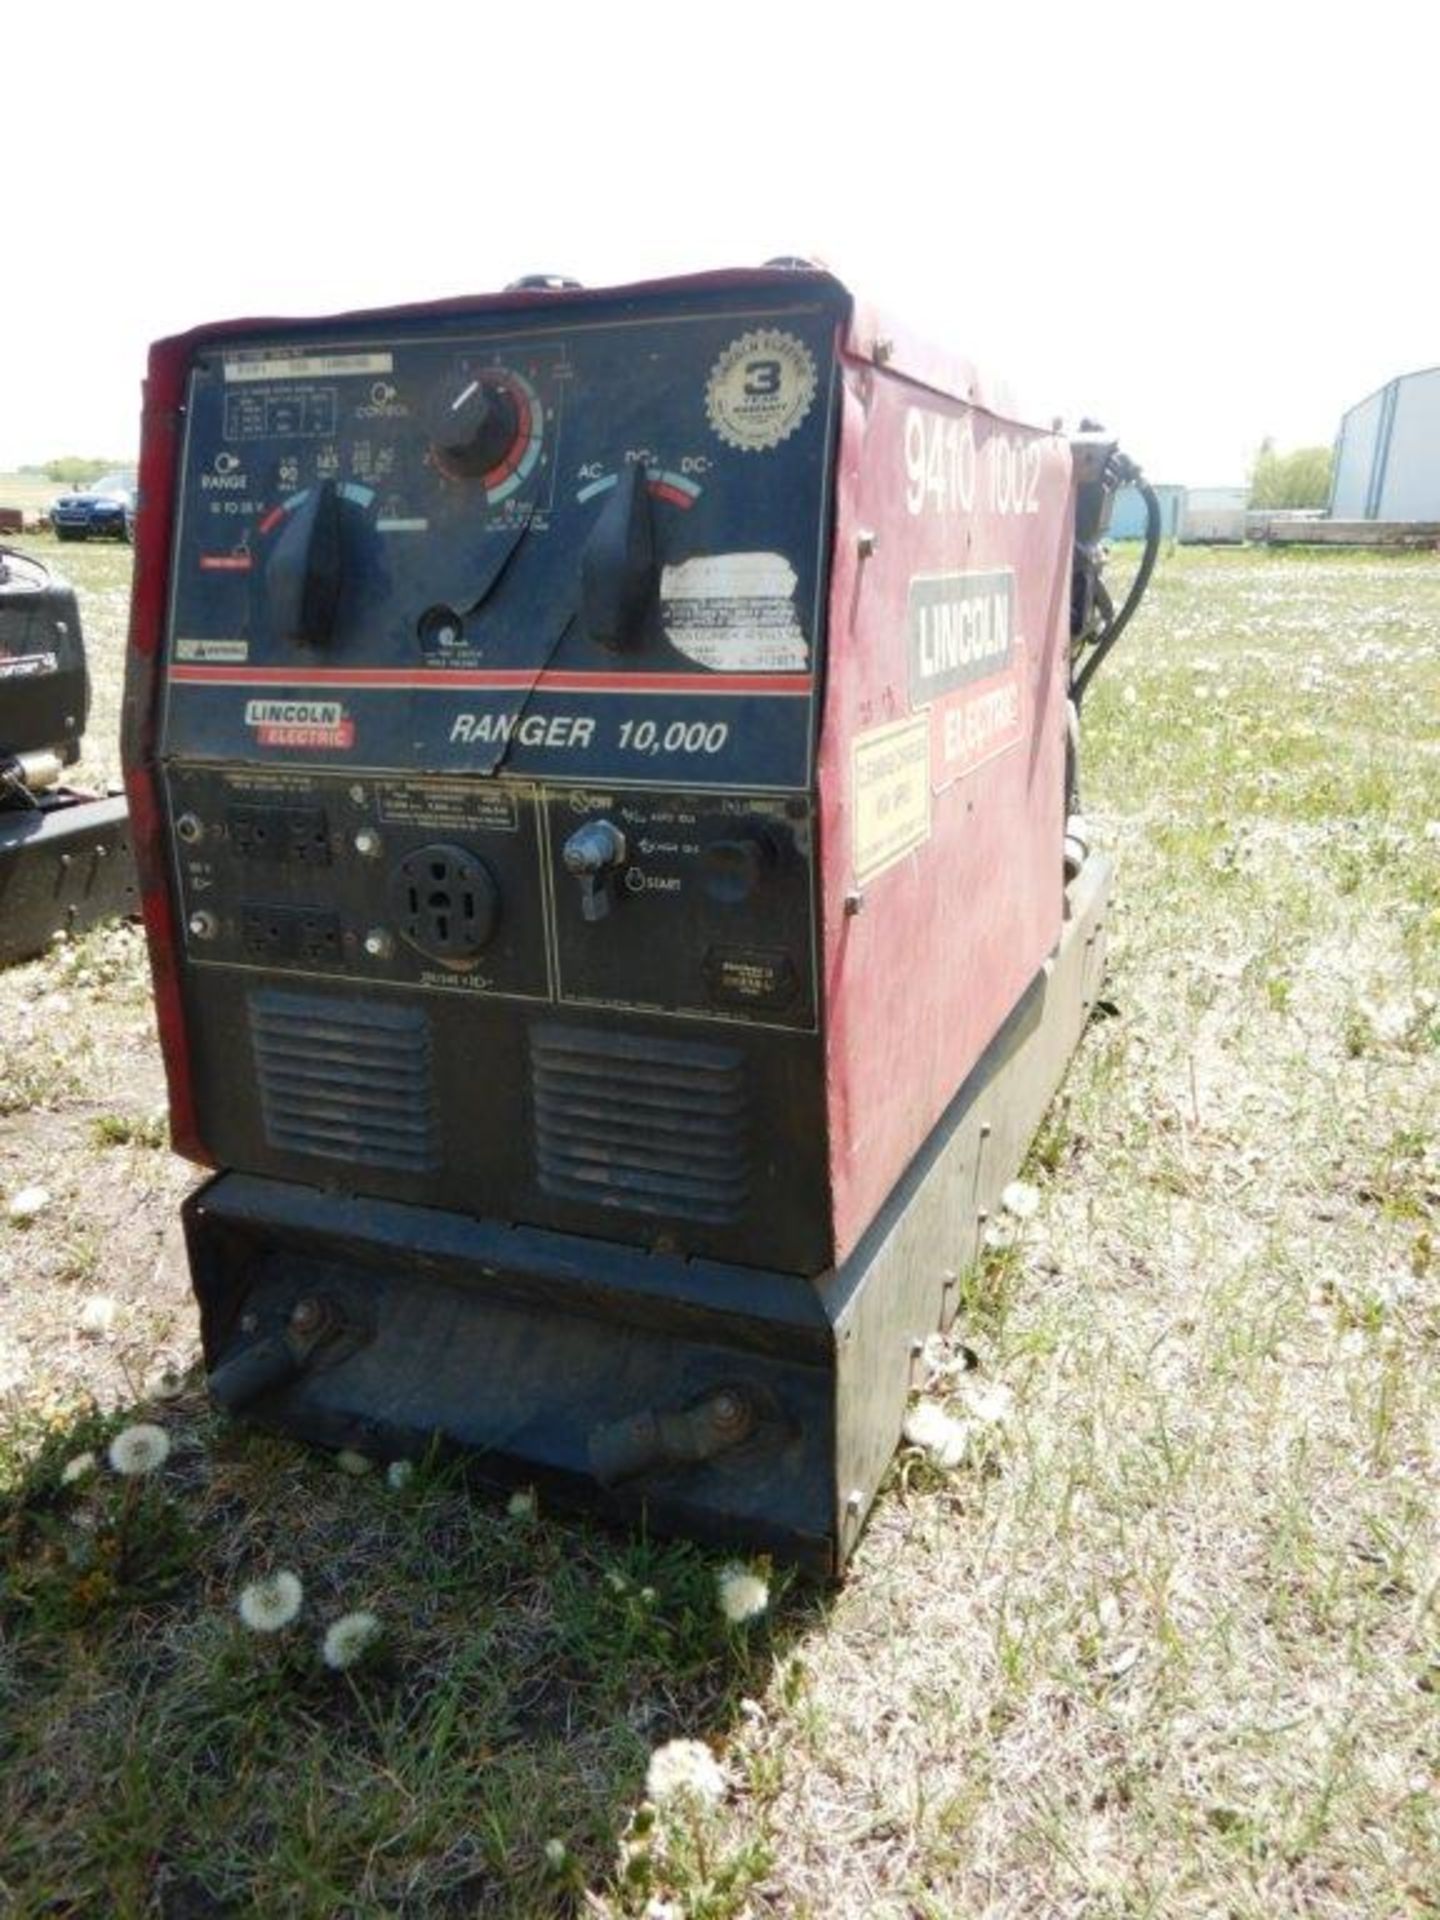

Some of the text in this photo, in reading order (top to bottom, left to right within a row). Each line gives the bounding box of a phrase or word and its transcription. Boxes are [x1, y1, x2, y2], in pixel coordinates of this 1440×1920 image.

[744, 360, 782, 395] 3
[576, 462, 604, 480] AC
[904, 405, 1041, 516] 9410 1002
[201, 475, 249, 490] RANGE
[278, 467, 299, 481] 90
[920, 592, 1008, 678] LINCOLN
[250, 704, 337, 725] LINCOLN
[943, 688, 1019, 762] ELECTRIC
[267, 727, 346, 748] ELECTRIC
[449, 712, 729, 755] RANGER 10,000
[645, 876, 682, 891] START
